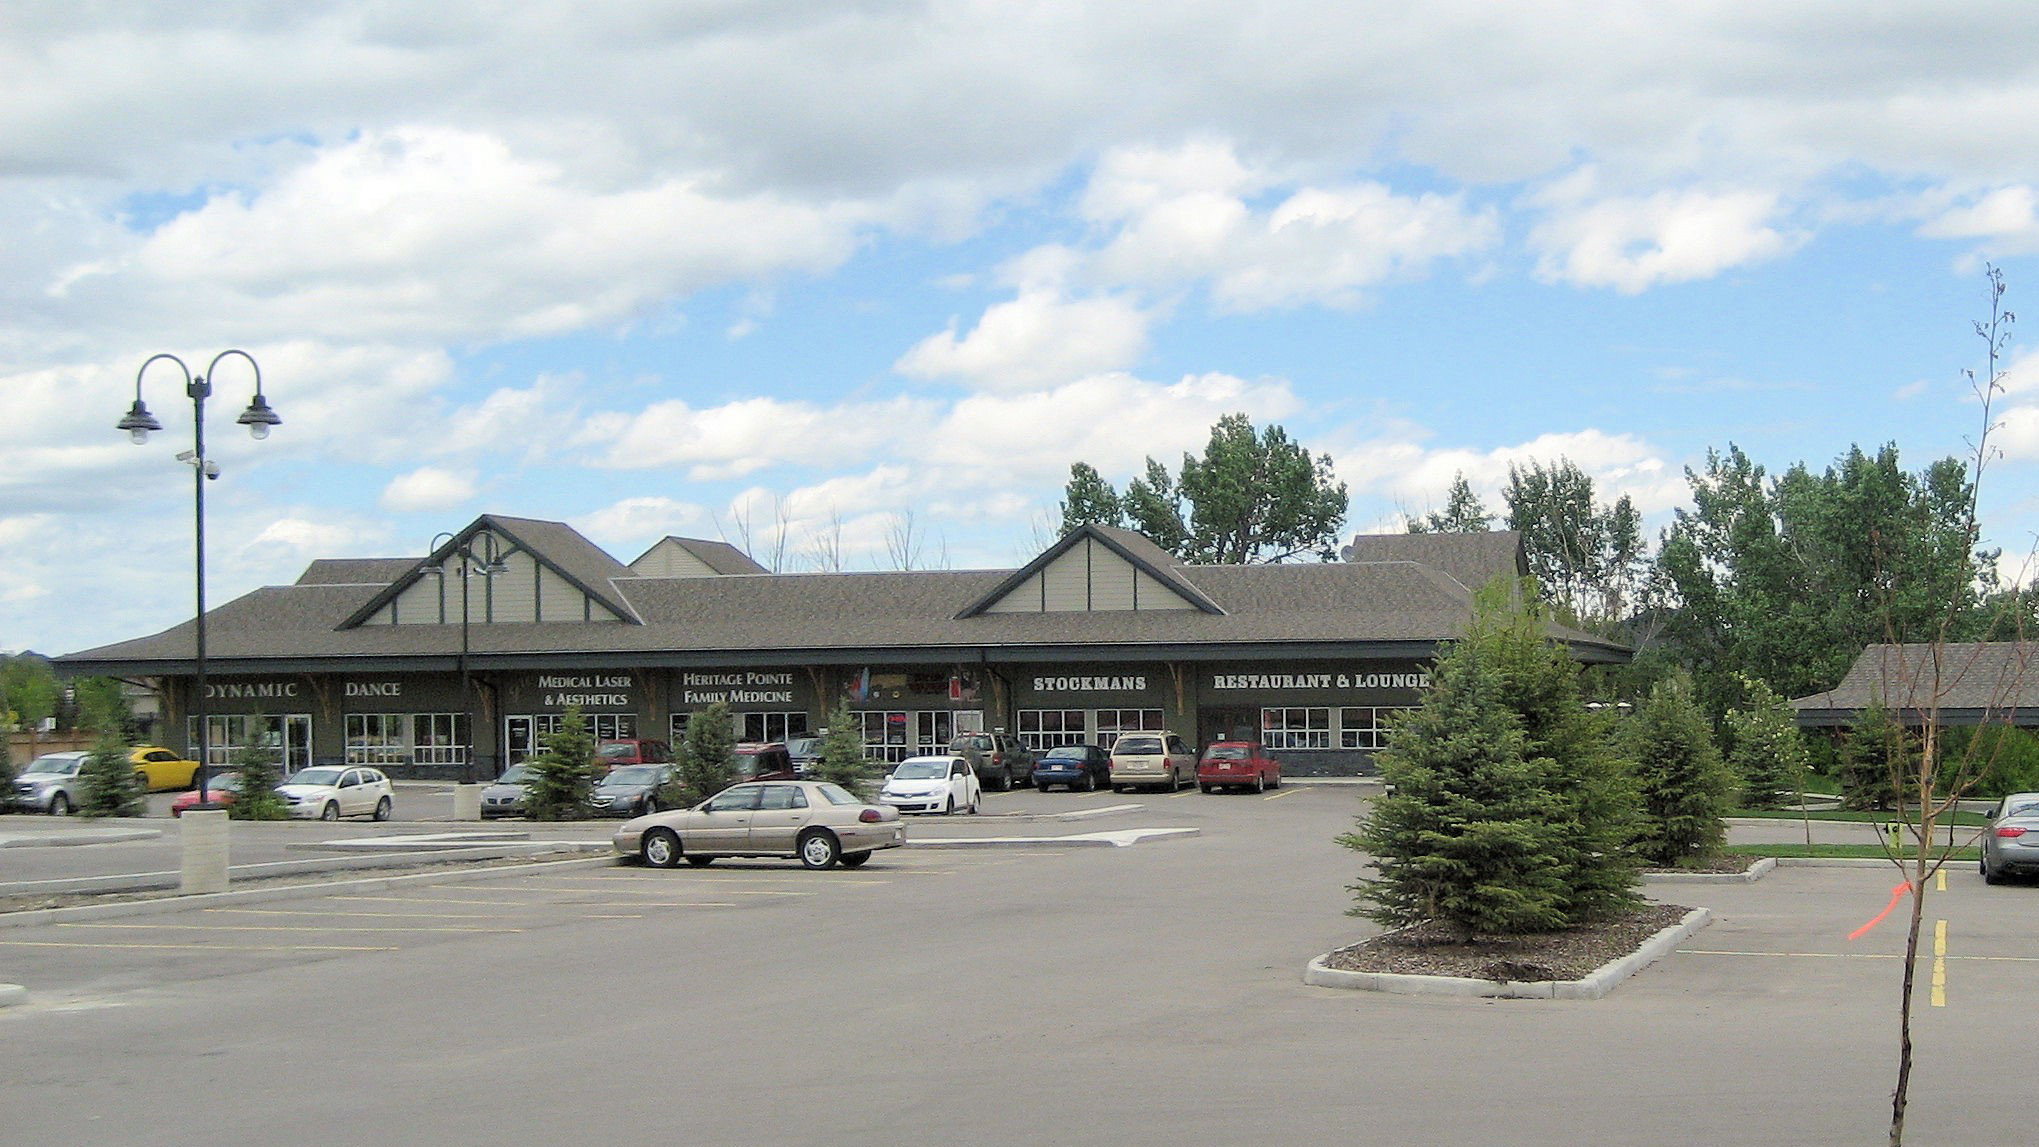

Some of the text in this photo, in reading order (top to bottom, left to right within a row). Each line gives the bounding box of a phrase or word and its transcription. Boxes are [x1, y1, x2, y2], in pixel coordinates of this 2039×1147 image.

[538, 675, 632, 688] MEDICAL LASER
[684, 672, 793, 685] HERITAGE POINTE
[1033, 676, 1147, 691] STOCKMANS
[1213, 673, 1430, 689] RESTAURANT & LOUNGE
[205, 683, 298, 698] DYNAMIC
[345, 682, 401, 696] DANCE
[683, 689, 793, 703] FAMILY MEDICINE
[544, 693, 629, 706] & AESTHETICS
